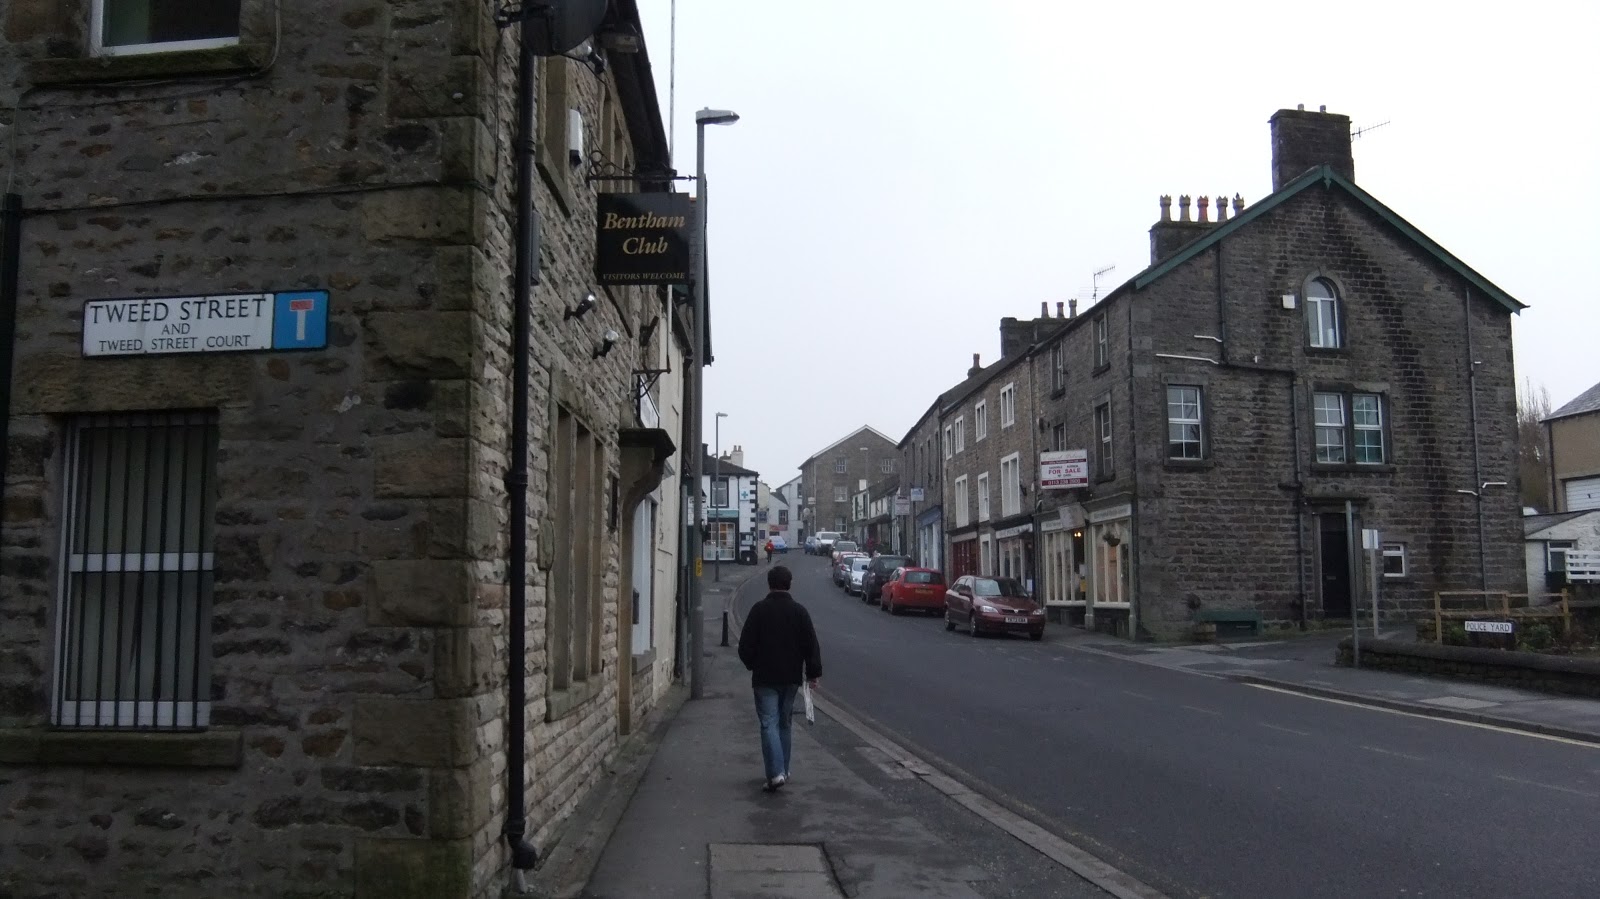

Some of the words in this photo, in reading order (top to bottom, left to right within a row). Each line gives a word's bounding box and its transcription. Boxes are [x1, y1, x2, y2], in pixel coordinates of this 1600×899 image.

[603, 211, 685, 229] Bentham
[622, 236, 669, 255] Club
[90, 302, 169, 324] TWEED
[180, 297, 266, 320] STREET
[161, 323, 190, 335] AND
[99, 339, 143, 352] TWEED
[151, 336, 198, 350] STREET
[206, 335, 251, 348] COURT
[1466, 622, 1487, 631] POLICE
[1490, 624, 1510, 632] YARD
